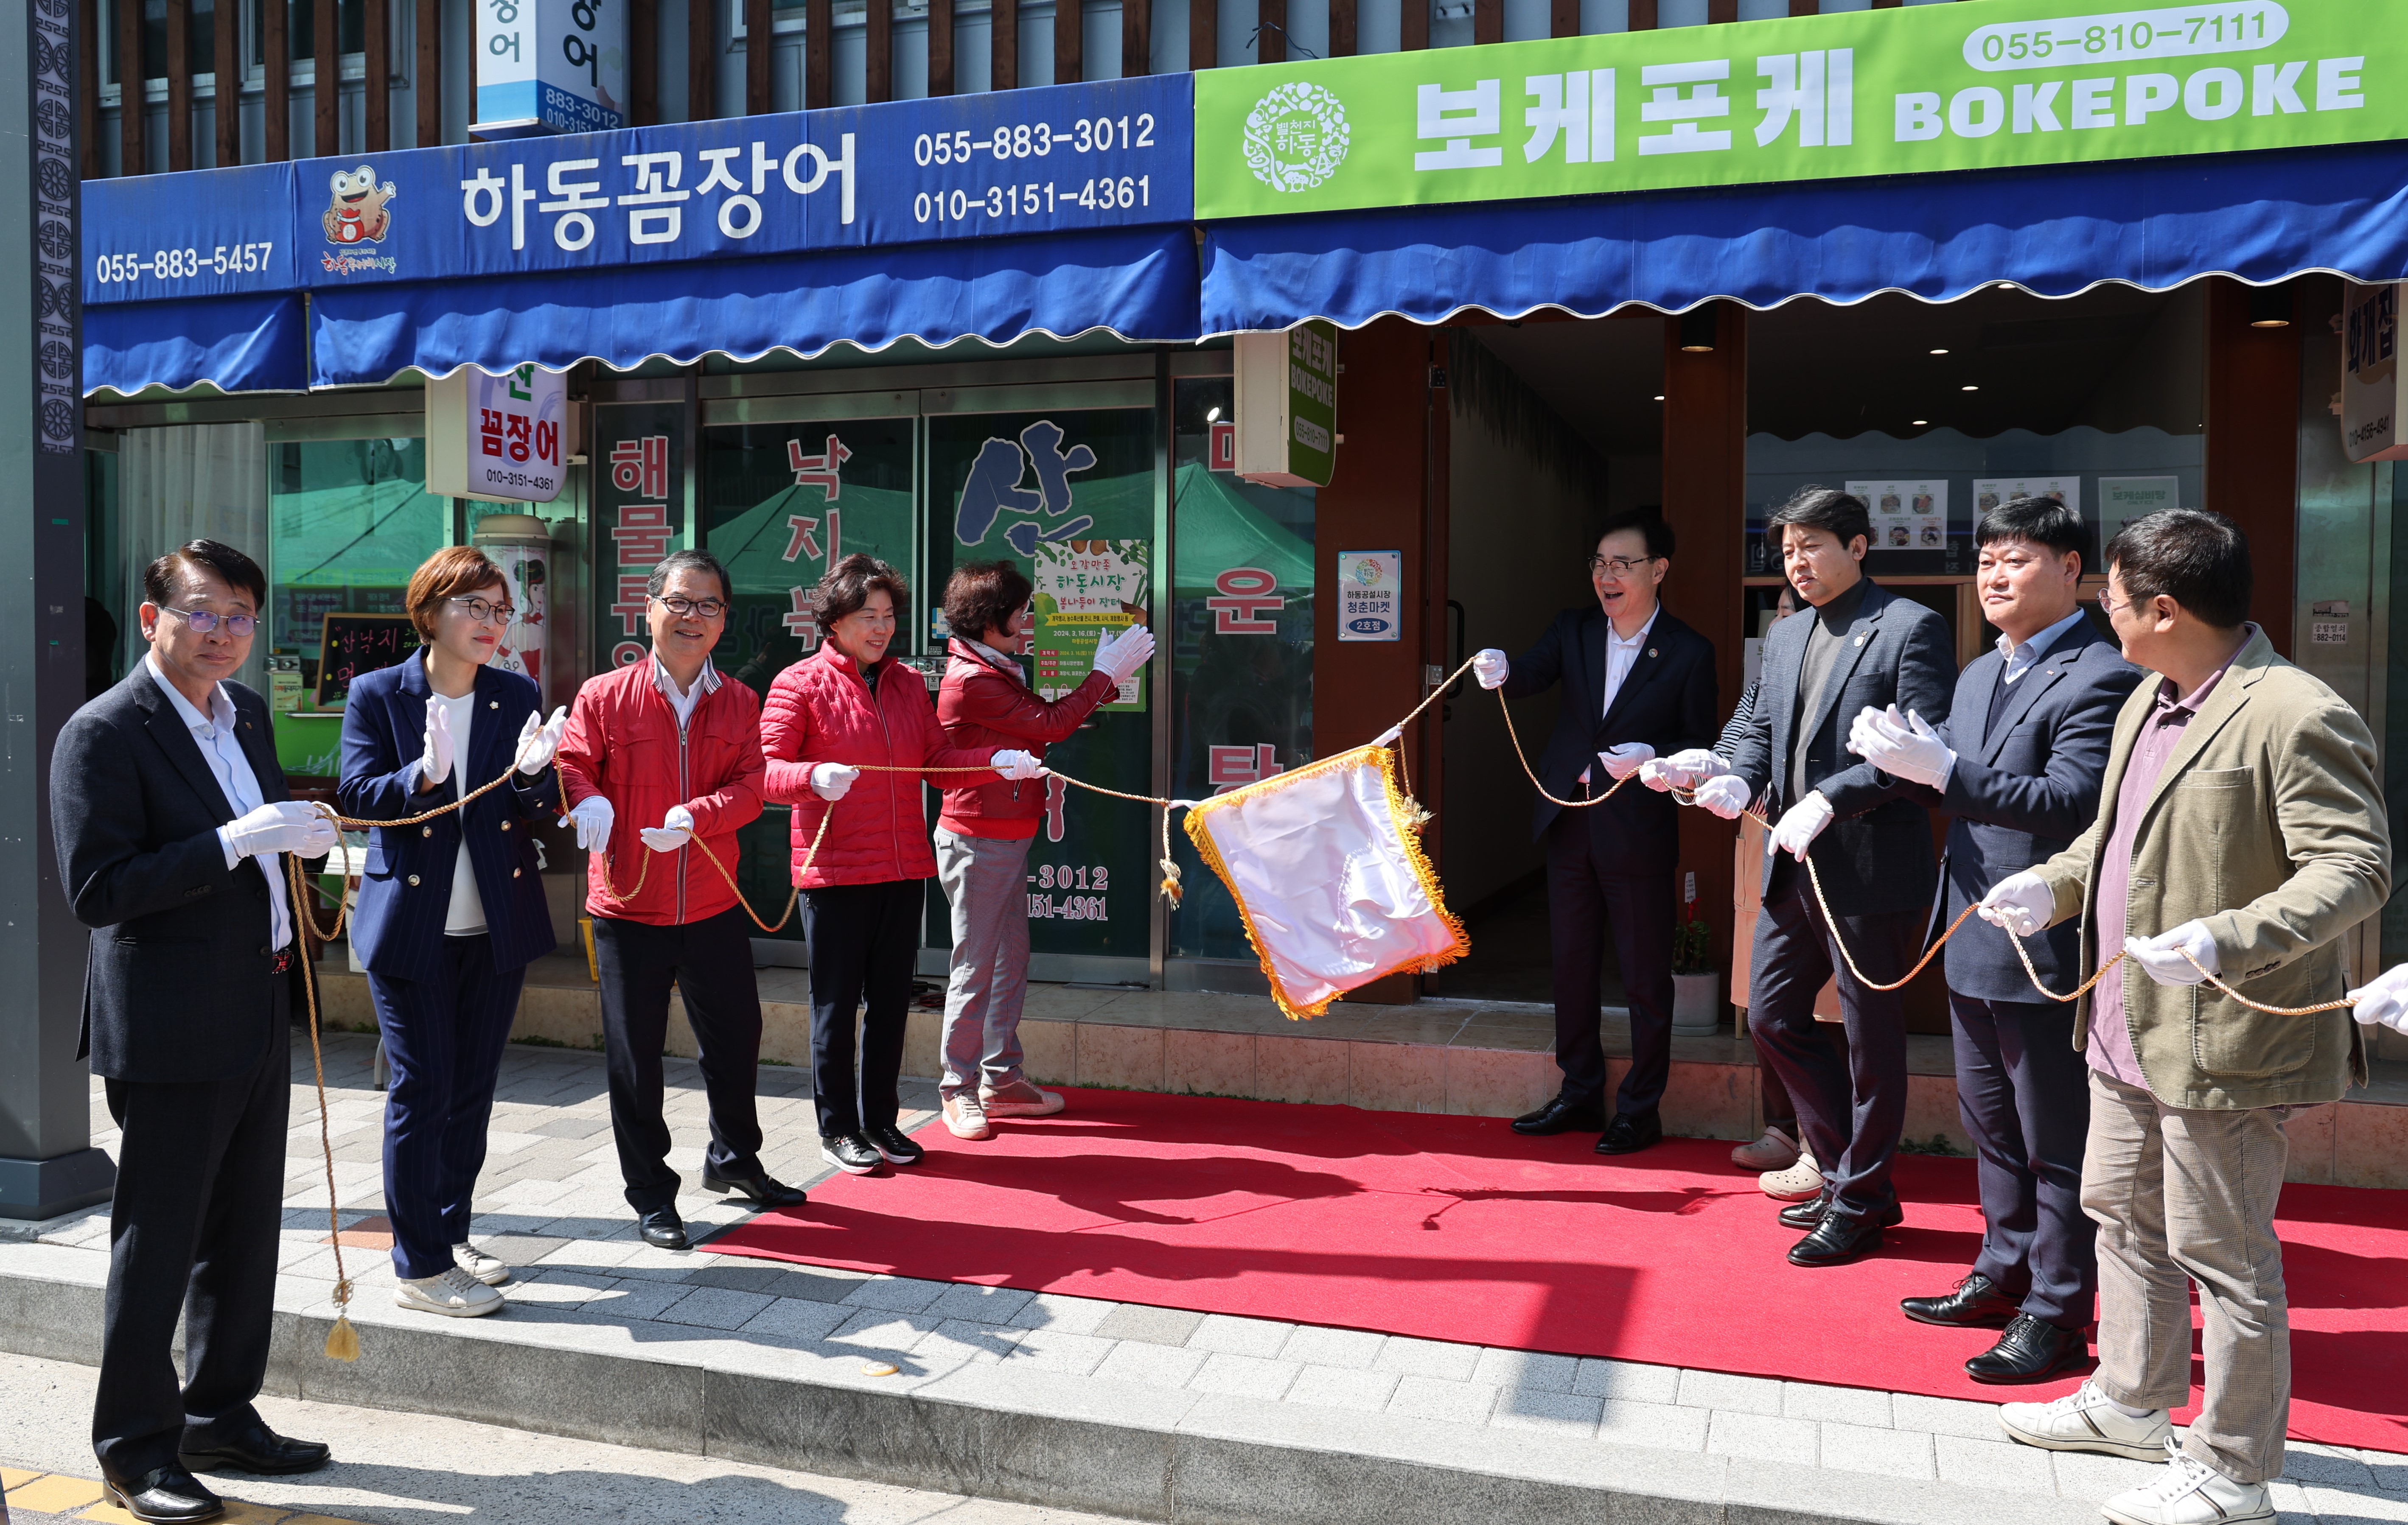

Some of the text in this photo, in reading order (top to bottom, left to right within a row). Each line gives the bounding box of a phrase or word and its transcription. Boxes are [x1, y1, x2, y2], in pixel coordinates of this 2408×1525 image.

[1982, 11, 2265, 62] 055-810-7111
[545, 88, 619, 129] 883-3012
[1414, 48, 1853, 171] 보케포케
[1895, 56, 2365, 142] BOKEPOKE
[914, 113, 1154, 166] 055-883-3012
[1276, 119, 1315, 135] 별천지
[1275, 134, 1316, 157] 하동
[461, 132, 855, 252] 하동꼼장어
[914, 174, 1148, 223] 010-3151-4361
[97, 242, 272, 284] 055-883-5457
[1291, 363, 1333, 408] BOKEPOKE
[480, 407, 559, 466] 꼼장어
[1296, 421, 1328, 449] 055-810-7111
[487, 469, 553, 490] 010-3151-4361
[1071, 558, 1110, 571] 오감만족
[1056, 573, 1126, 594] 하동시장
[1347, 590, 1391, 599] 하동공설시장
[1060, 596, 1121, 610] 봄나들이 장터
[1347, 602, 1390, 613] 청춘마켓
[1357, 621, 1380, 631] 2호점
[2317, 633, 2346, 641] 882-0114
